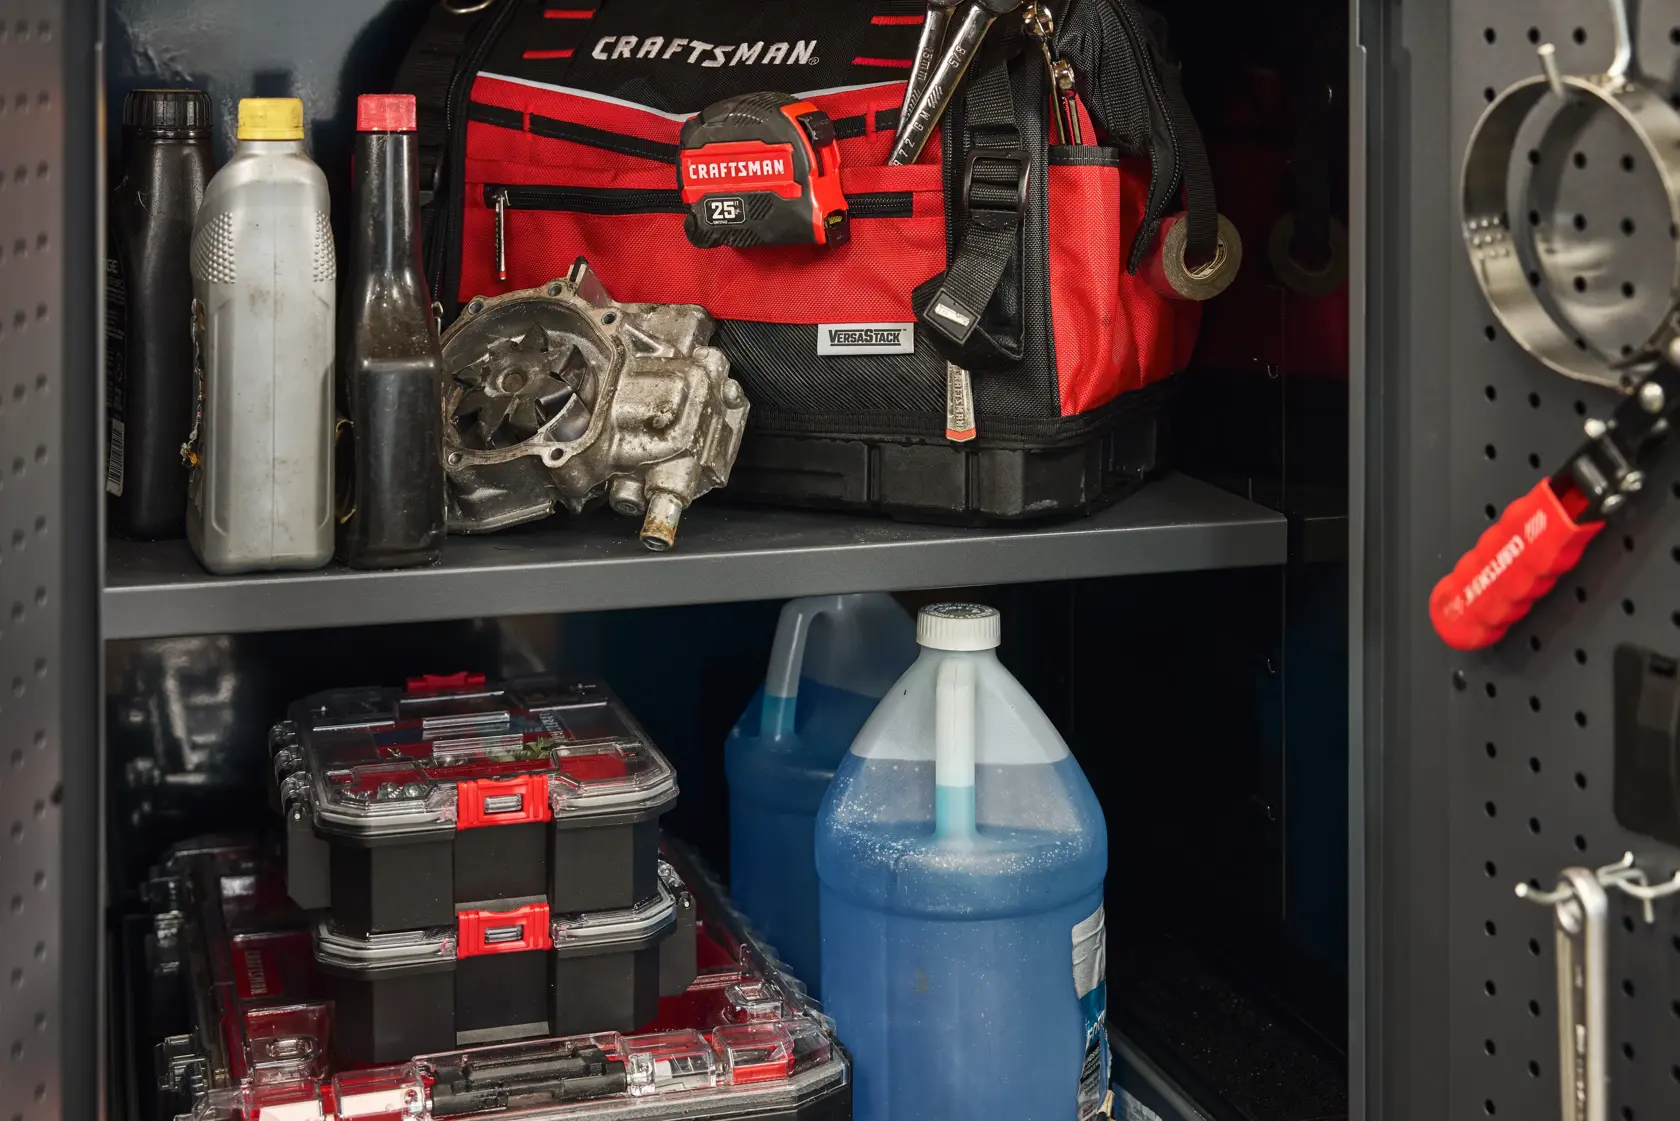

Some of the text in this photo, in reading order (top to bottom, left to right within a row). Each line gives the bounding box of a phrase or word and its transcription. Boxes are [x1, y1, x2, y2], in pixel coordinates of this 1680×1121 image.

[591, 35, 818, 68] CRAFTSMAN
[948, 45, 967, 68] 5/8
[688, 159, 785, 180] CRAFTSMAN
[711, 201, 736, 219] 25
